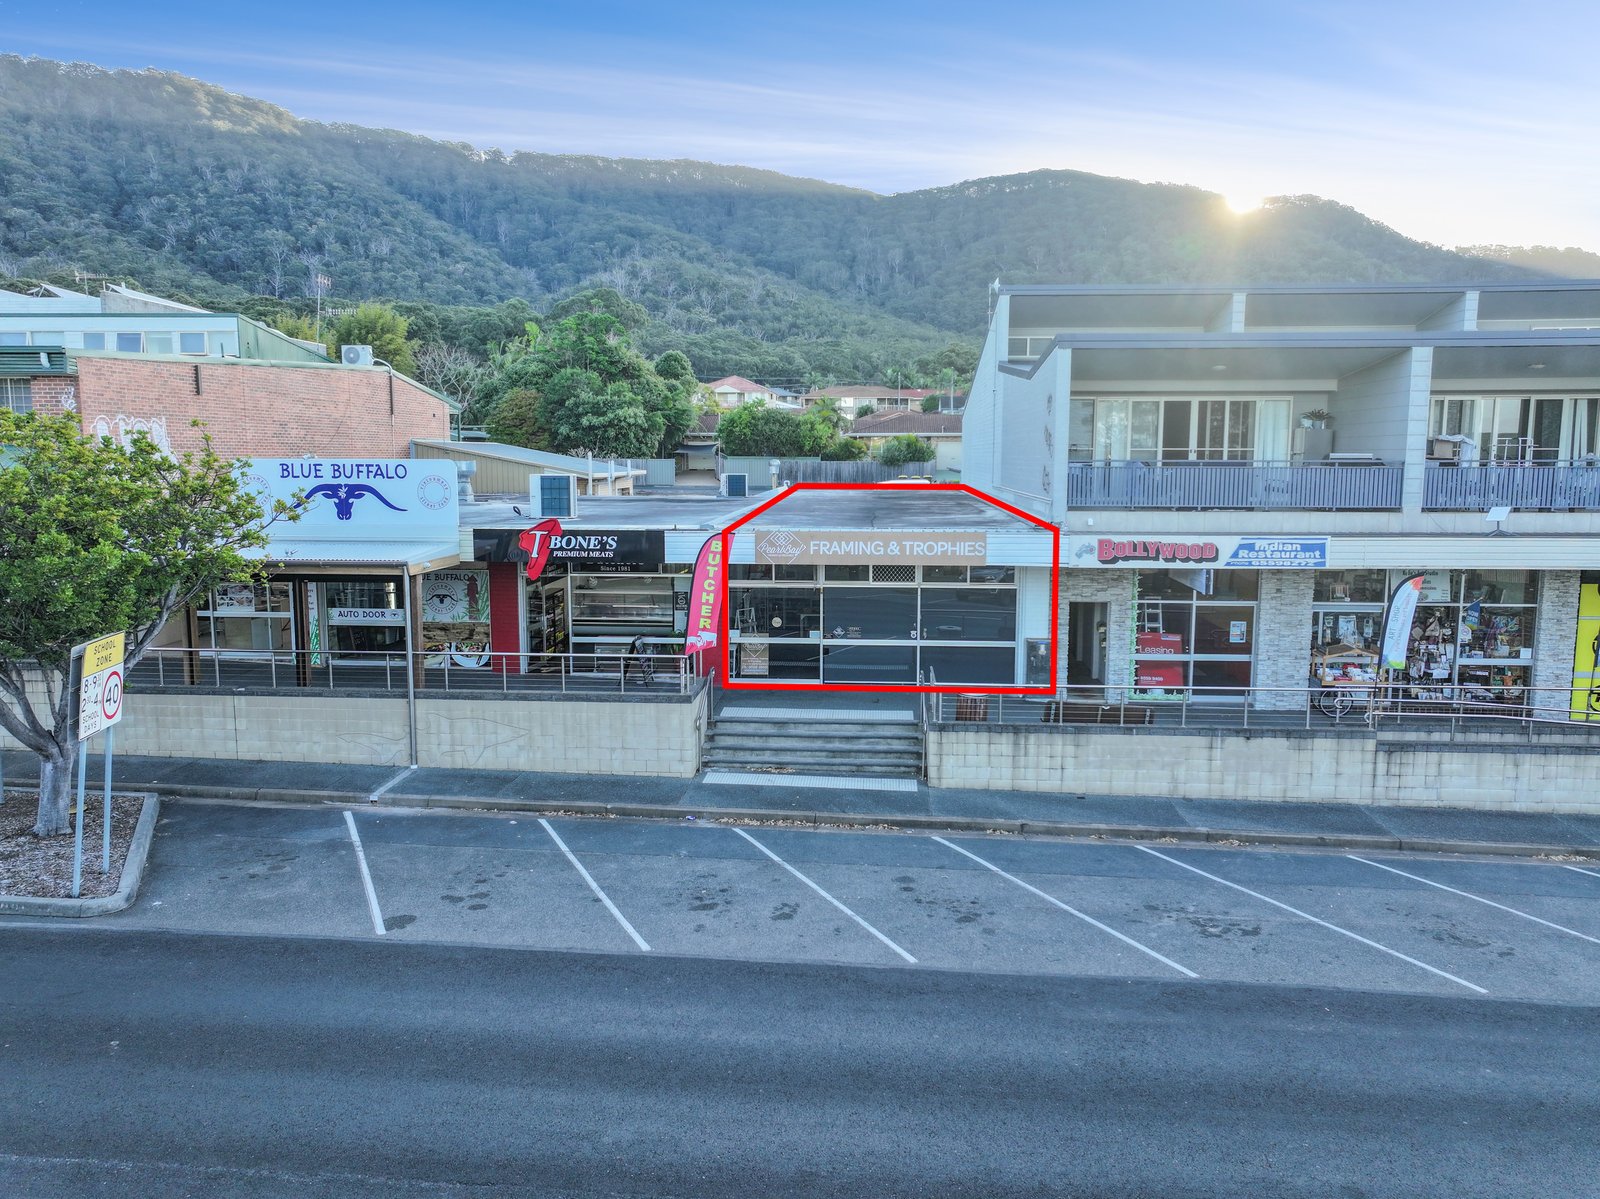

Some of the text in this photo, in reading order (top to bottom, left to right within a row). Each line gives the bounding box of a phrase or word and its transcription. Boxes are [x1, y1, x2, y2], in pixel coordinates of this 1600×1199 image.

[279, 463, 408, 479] BLUE BUFFALO
[529, 530, 618, 558] T BONE'S
[810, 541, 985, 556] FRAMING & TROPHIES
[1097, 538, 1219, 565] BOLLYWOOD
[1254, 541, 1302, 551] Indian
[1237, 549, 1321, 559] Restaurant
[698, 540, 723, 630] BUTCHER
[338, 610, 387, 618] AUTO DOOR
[93, 639, 116, 655] SCHOOL
[96, 653, 112, 667] ZONE
[105, 683, 119, 706] 40
